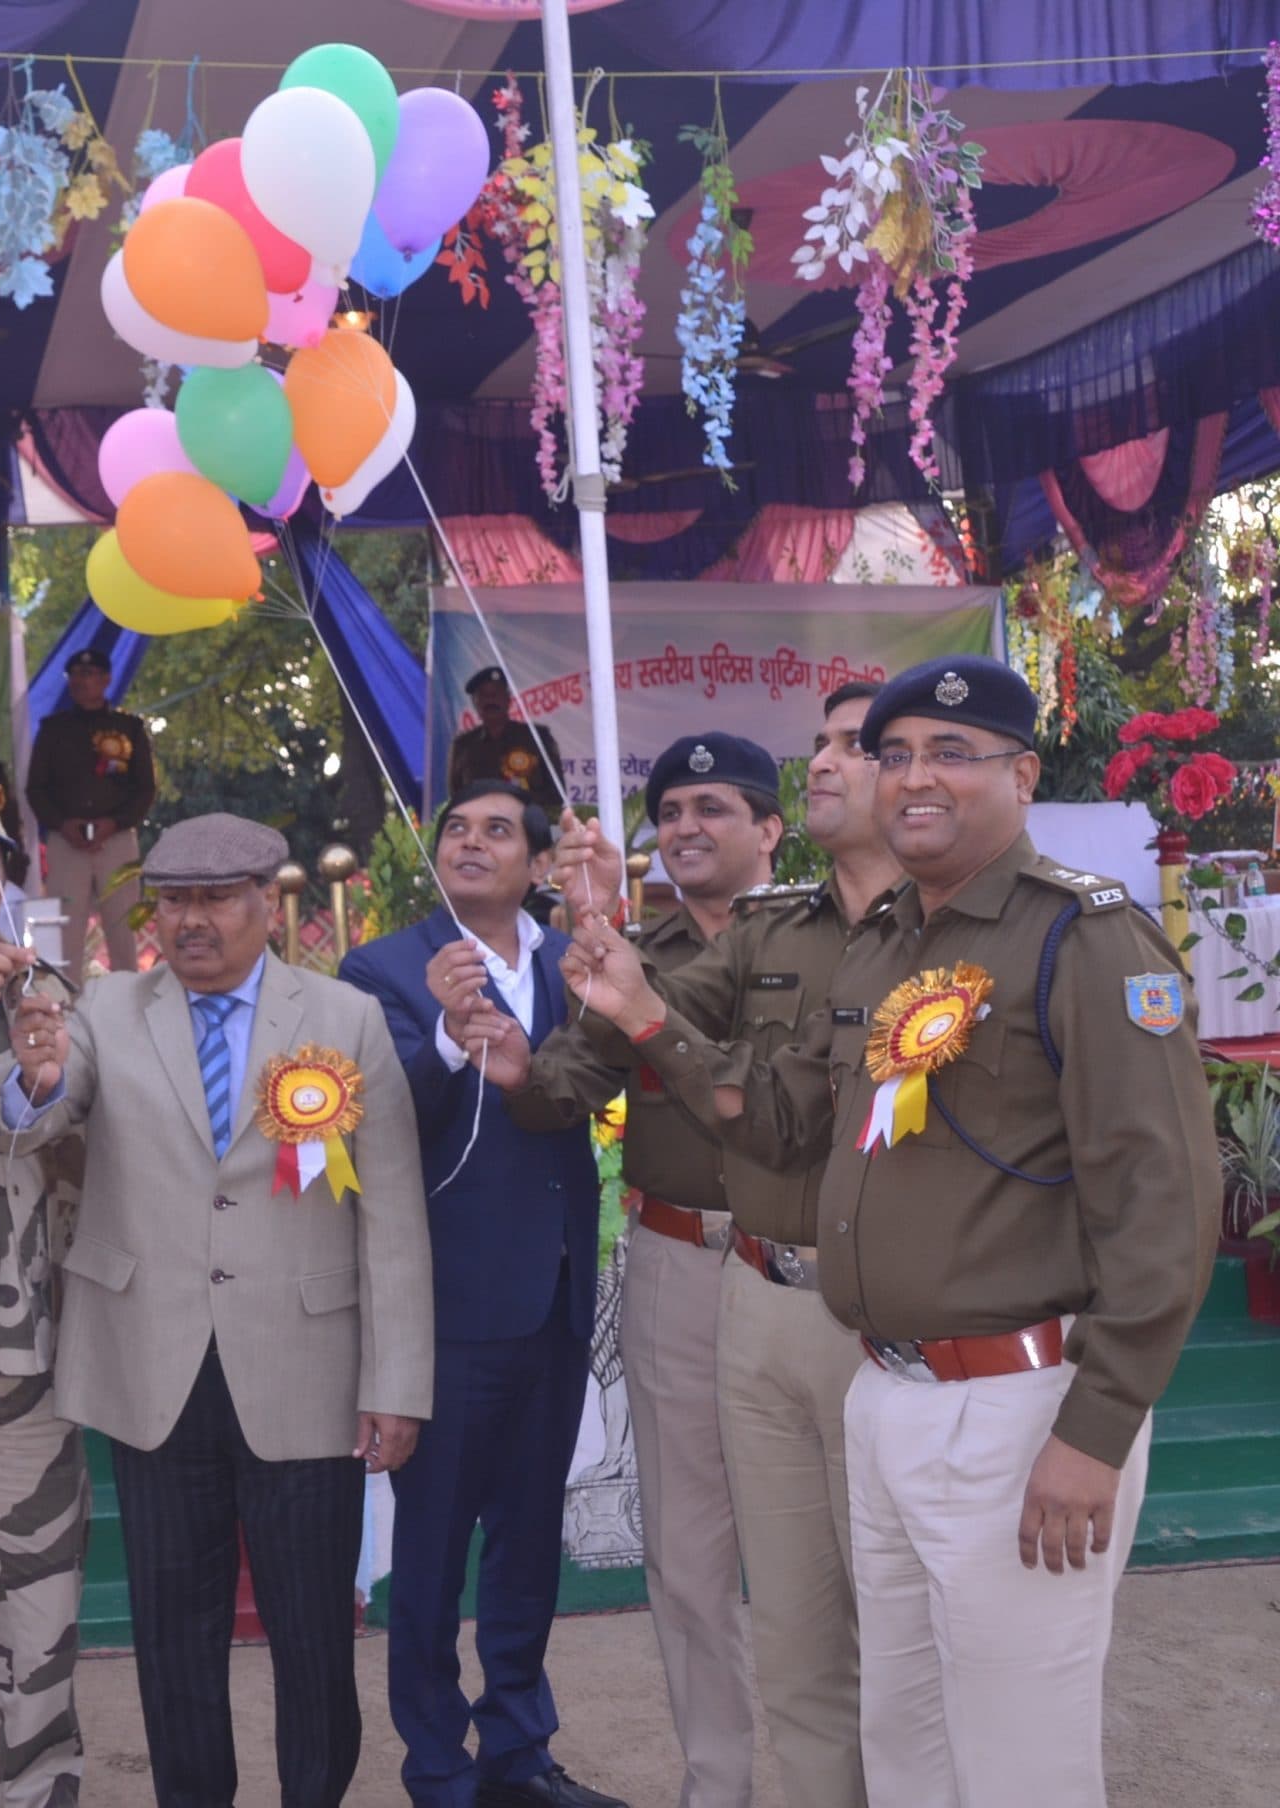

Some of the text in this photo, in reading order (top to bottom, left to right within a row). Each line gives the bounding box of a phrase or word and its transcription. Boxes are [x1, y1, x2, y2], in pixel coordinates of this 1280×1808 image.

[637, 644, 695, 688] स्तरीय
[699, 641, 754, 699] पुलिस
[760, 647, 811, 700] शूटिंग
[1090, 887, 1124, 906] IPS
